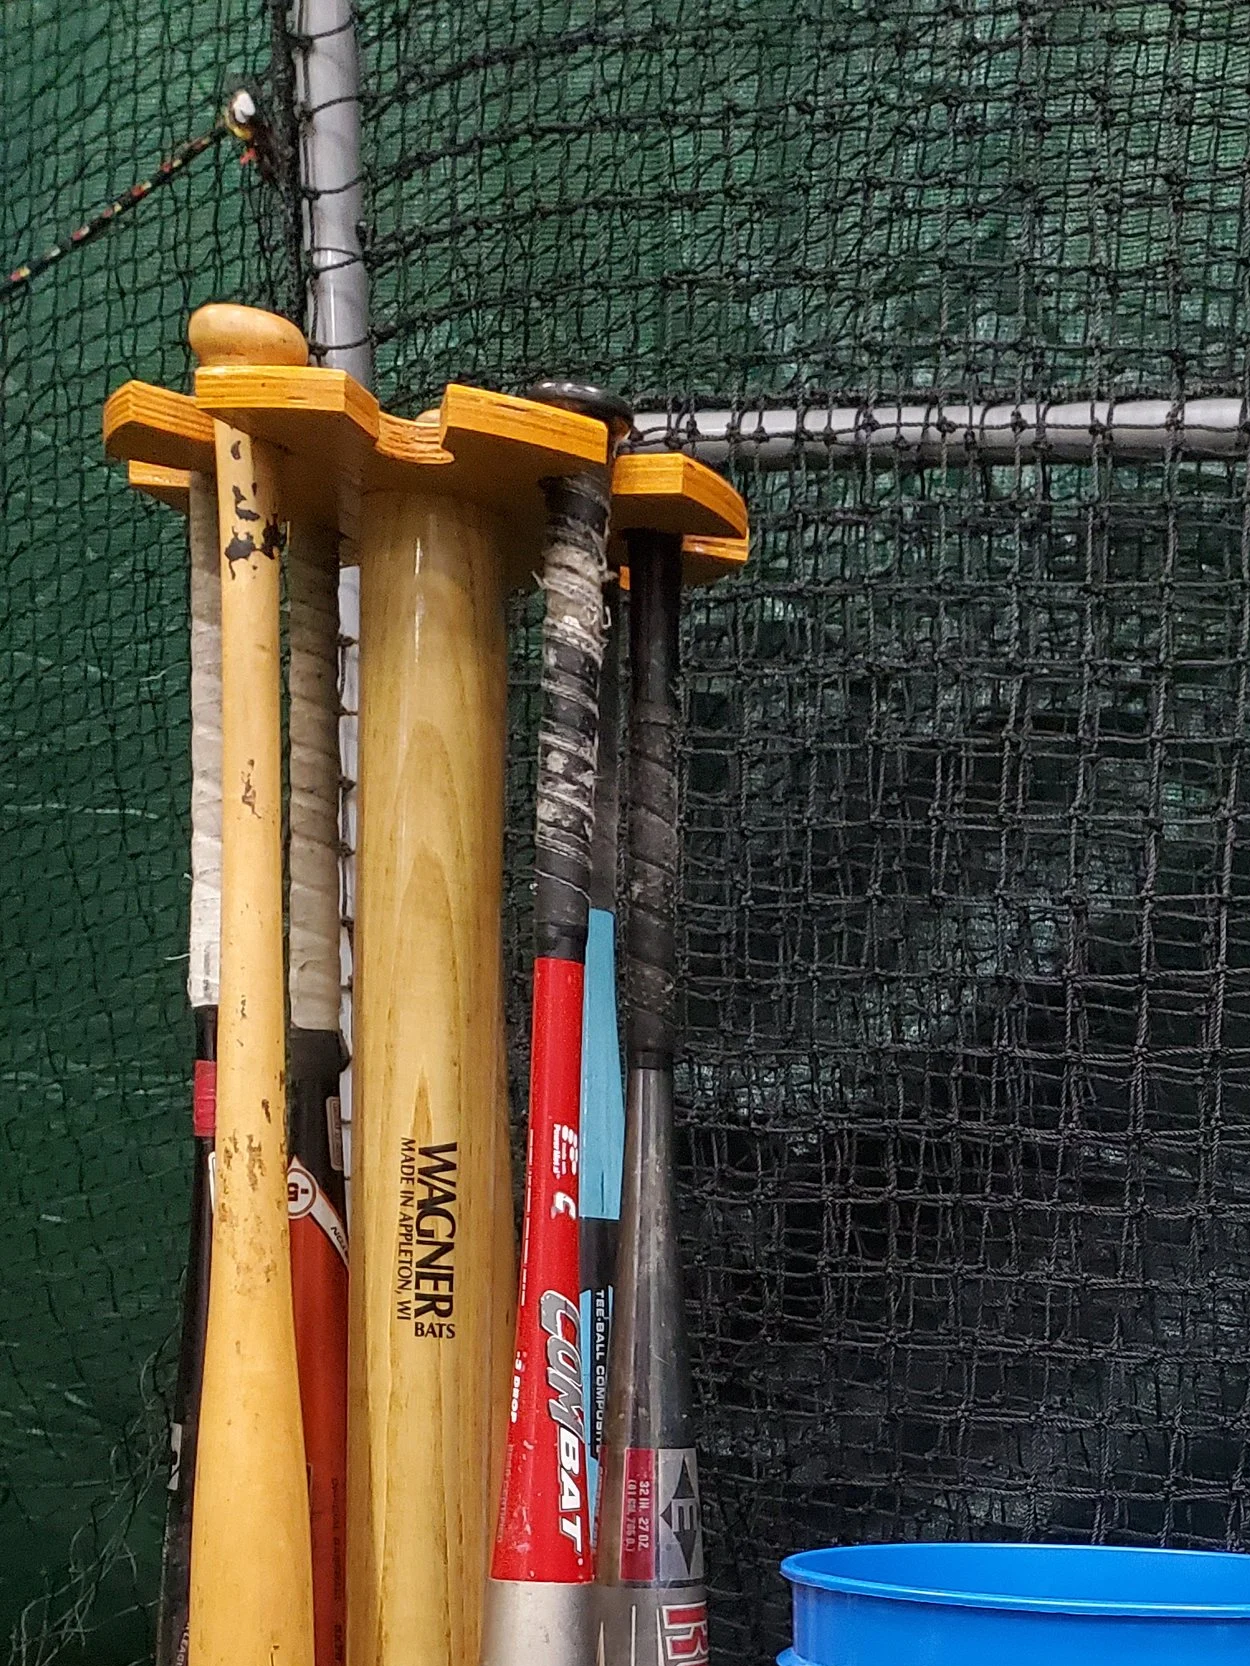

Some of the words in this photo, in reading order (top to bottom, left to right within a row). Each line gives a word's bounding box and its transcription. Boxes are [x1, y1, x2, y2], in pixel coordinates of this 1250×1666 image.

[400, 1137, 416, 1185] MADE
[399, 1191, 414, 1208] IN
[414, 1142, 457, 1318] WAGNER
[394, 1211, 413, 1293] APPLETON,
[396, 1300, 411, 1320] WI
[414, 1322, 456, 1339] BATS
[540, 1289, 585, 1556] COMBAT
[638, 1481, 650, 1495] 32
[638, 1517, 650, 1532] 27
